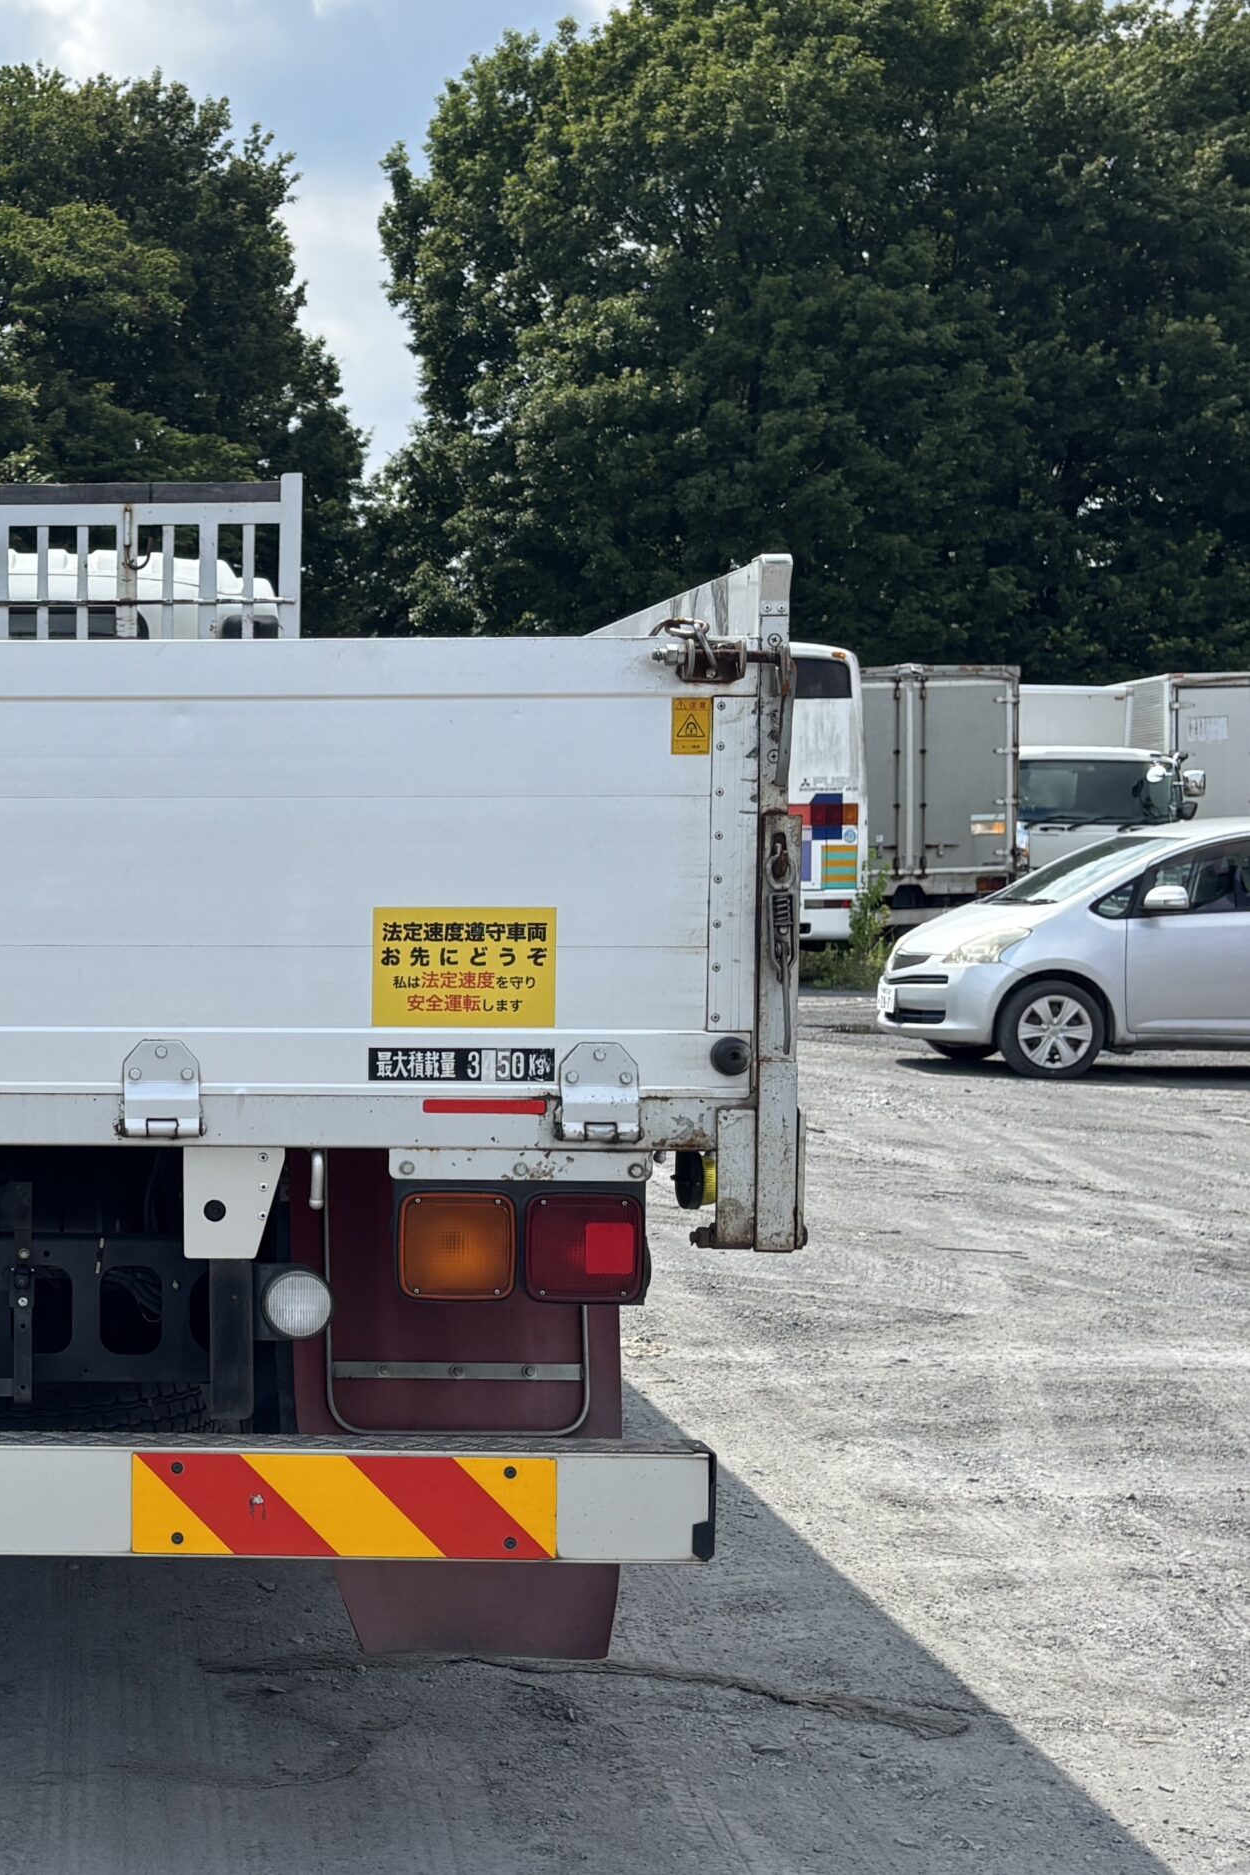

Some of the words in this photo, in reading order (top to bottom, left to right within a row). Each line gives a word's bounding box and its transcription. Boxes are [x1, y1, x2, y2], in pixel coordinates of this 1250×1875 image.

[382, 922, 548, 942] 法定速度遵守車両
[381, 947, 548, 967] お先にどうぞ
[393, 971, 536, 989] 私は法定速度を守り
[407, 994, 523, 1012] 安全運転します
[376, 1051, 456, 1078] 最大積載量
